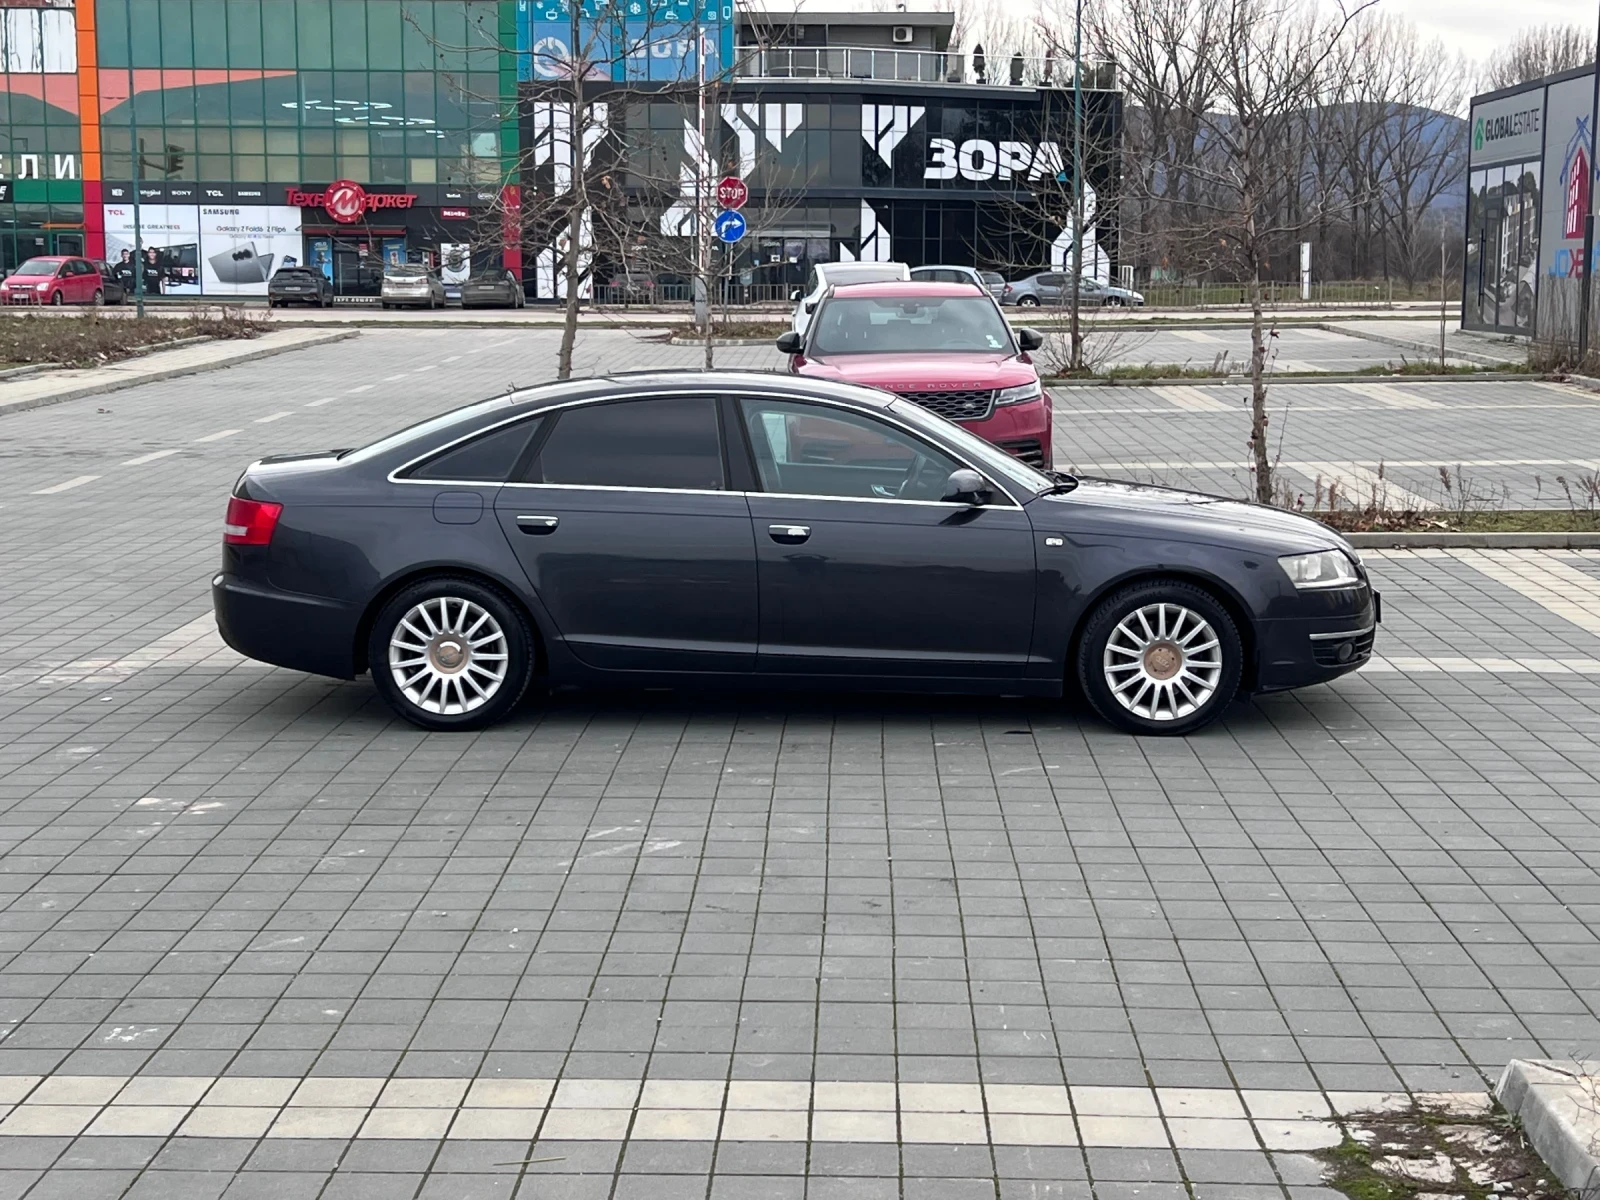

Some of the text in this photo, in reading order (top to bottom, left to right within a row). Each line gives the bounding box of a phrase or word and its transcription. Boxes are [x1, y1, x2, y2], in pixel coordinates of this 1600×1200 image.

[0, 154, 75, 179] ЛИ
[924, 138, 1067, 181] ЗОРА
[720, 187, 744, 199] STOP
